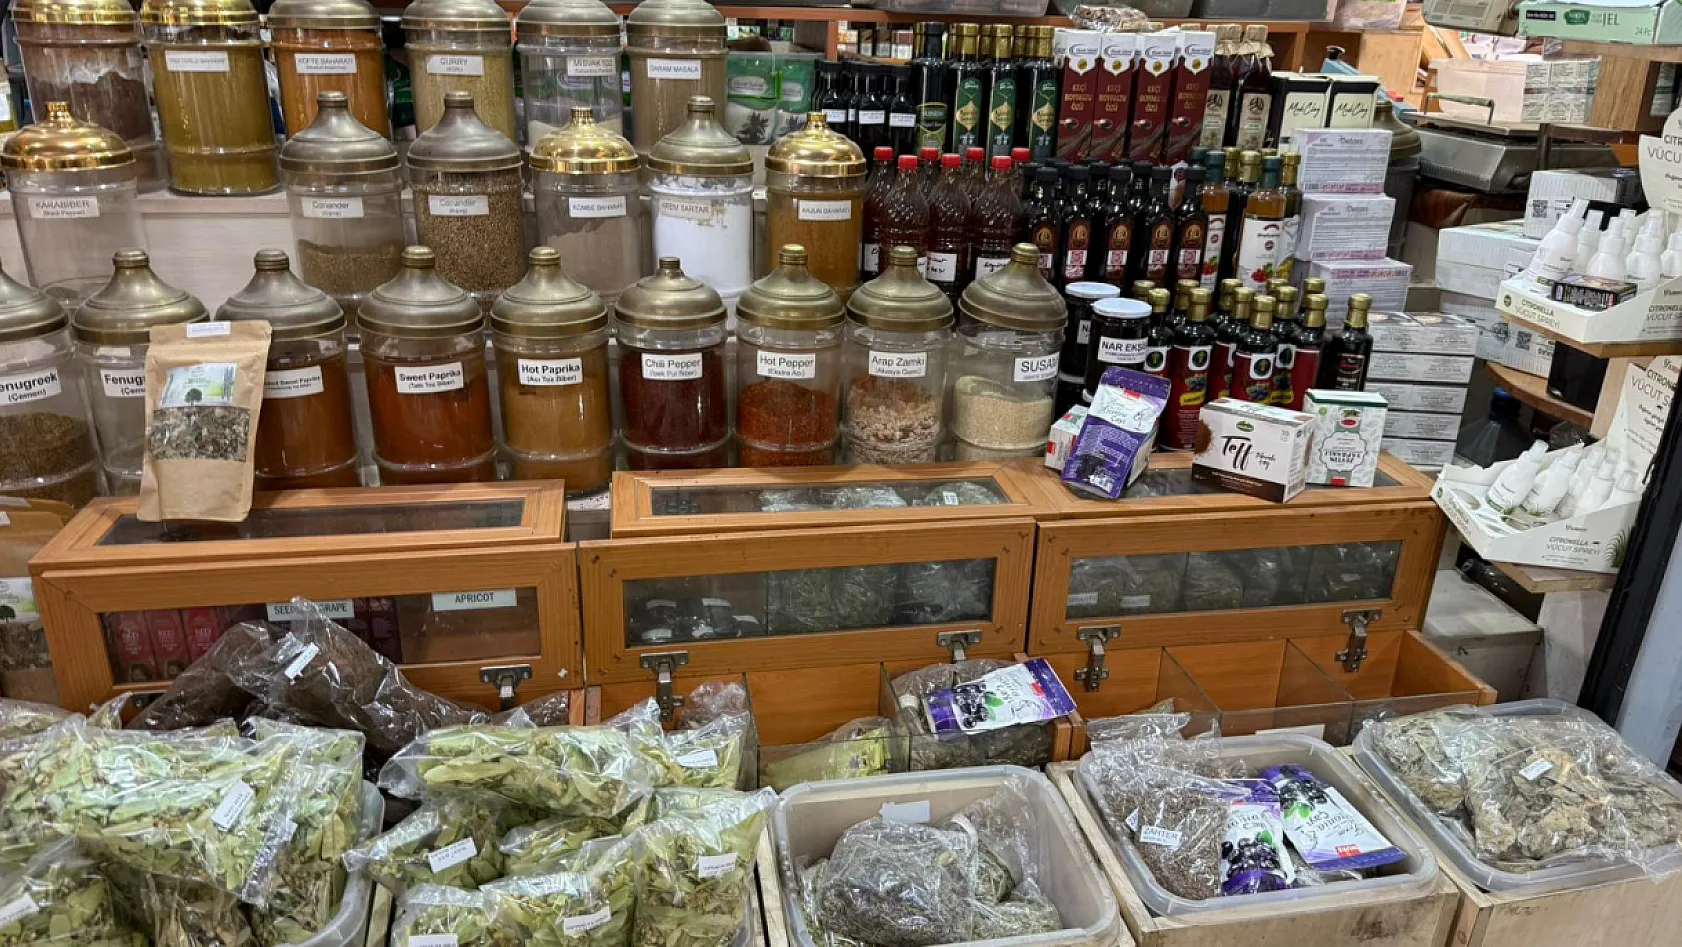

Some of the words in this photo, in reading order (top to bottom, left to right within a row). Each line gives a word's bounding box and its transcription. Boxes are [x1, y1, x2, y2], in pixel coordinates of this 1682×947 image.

[1602, 11, 1620, 27] JEL
[440, 57, 468, 66] CURRY
[673, 65, 699, 73] MASALA
[312, 200, 350, 210] Coriander
[439, 199, 476, 208] Coriander
[1102, 340, 1124, 352] NAR
[668, 359, 701, 371] Pepper
[760, 355, 776, 366] Hot
[778, 357, 813, 370] Pepper
[872, 355, 894, 367] Arap
[522, 364, 540, 374] Hot
[542, 363, 580, 375] Paprika
[399, 373, 427, 382] Sweet
[429, 369, 461, 381] Paprika
[1221, 435, 1253, 471] Teff
[455, 592, 495, 603] APRICOT
